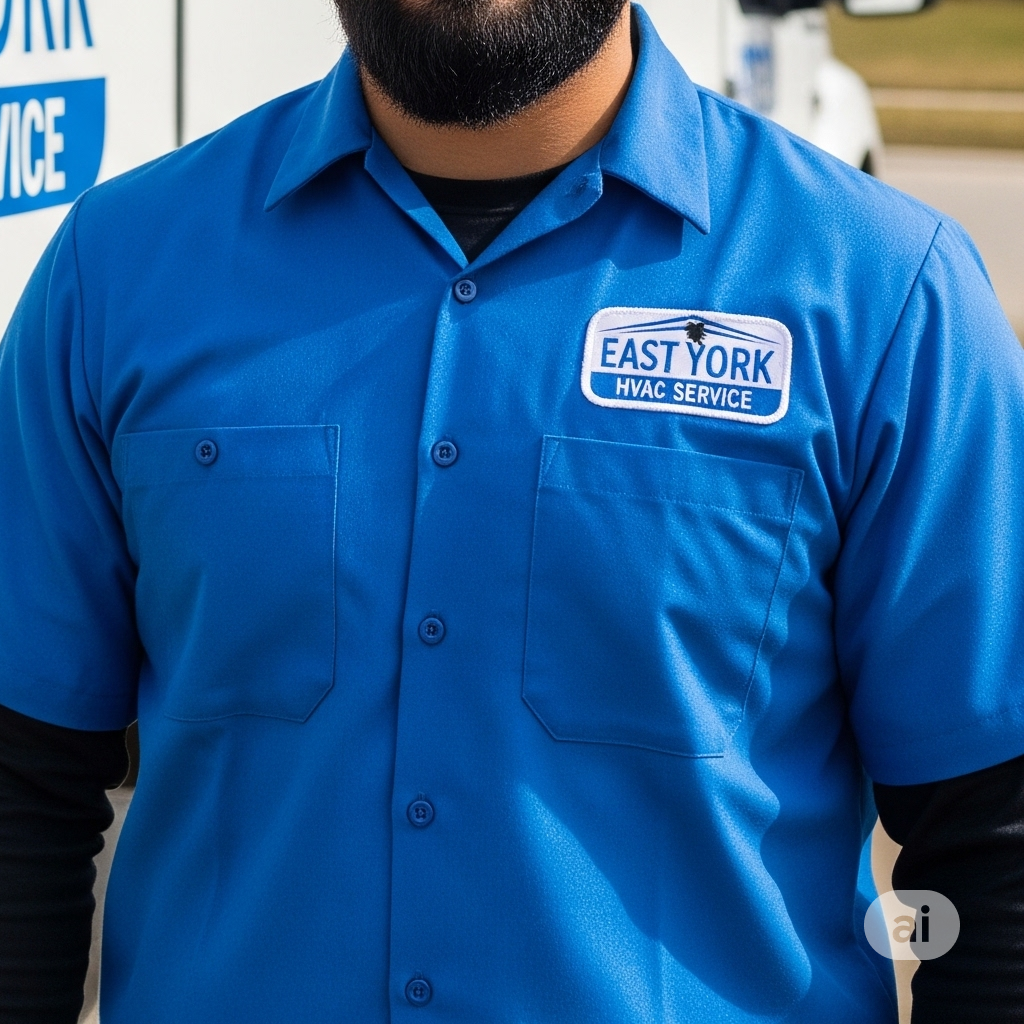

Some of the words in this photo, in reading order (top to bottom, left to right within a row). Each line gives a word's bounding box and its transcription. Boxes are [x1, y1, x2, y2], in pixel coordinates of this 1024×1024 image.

[600, 337, 680, 374] EAST
[685, 341, 775, 384] YORK
[615, 376, 666, 399] HVAC
[673, 381, 753, 410] SERVICE
